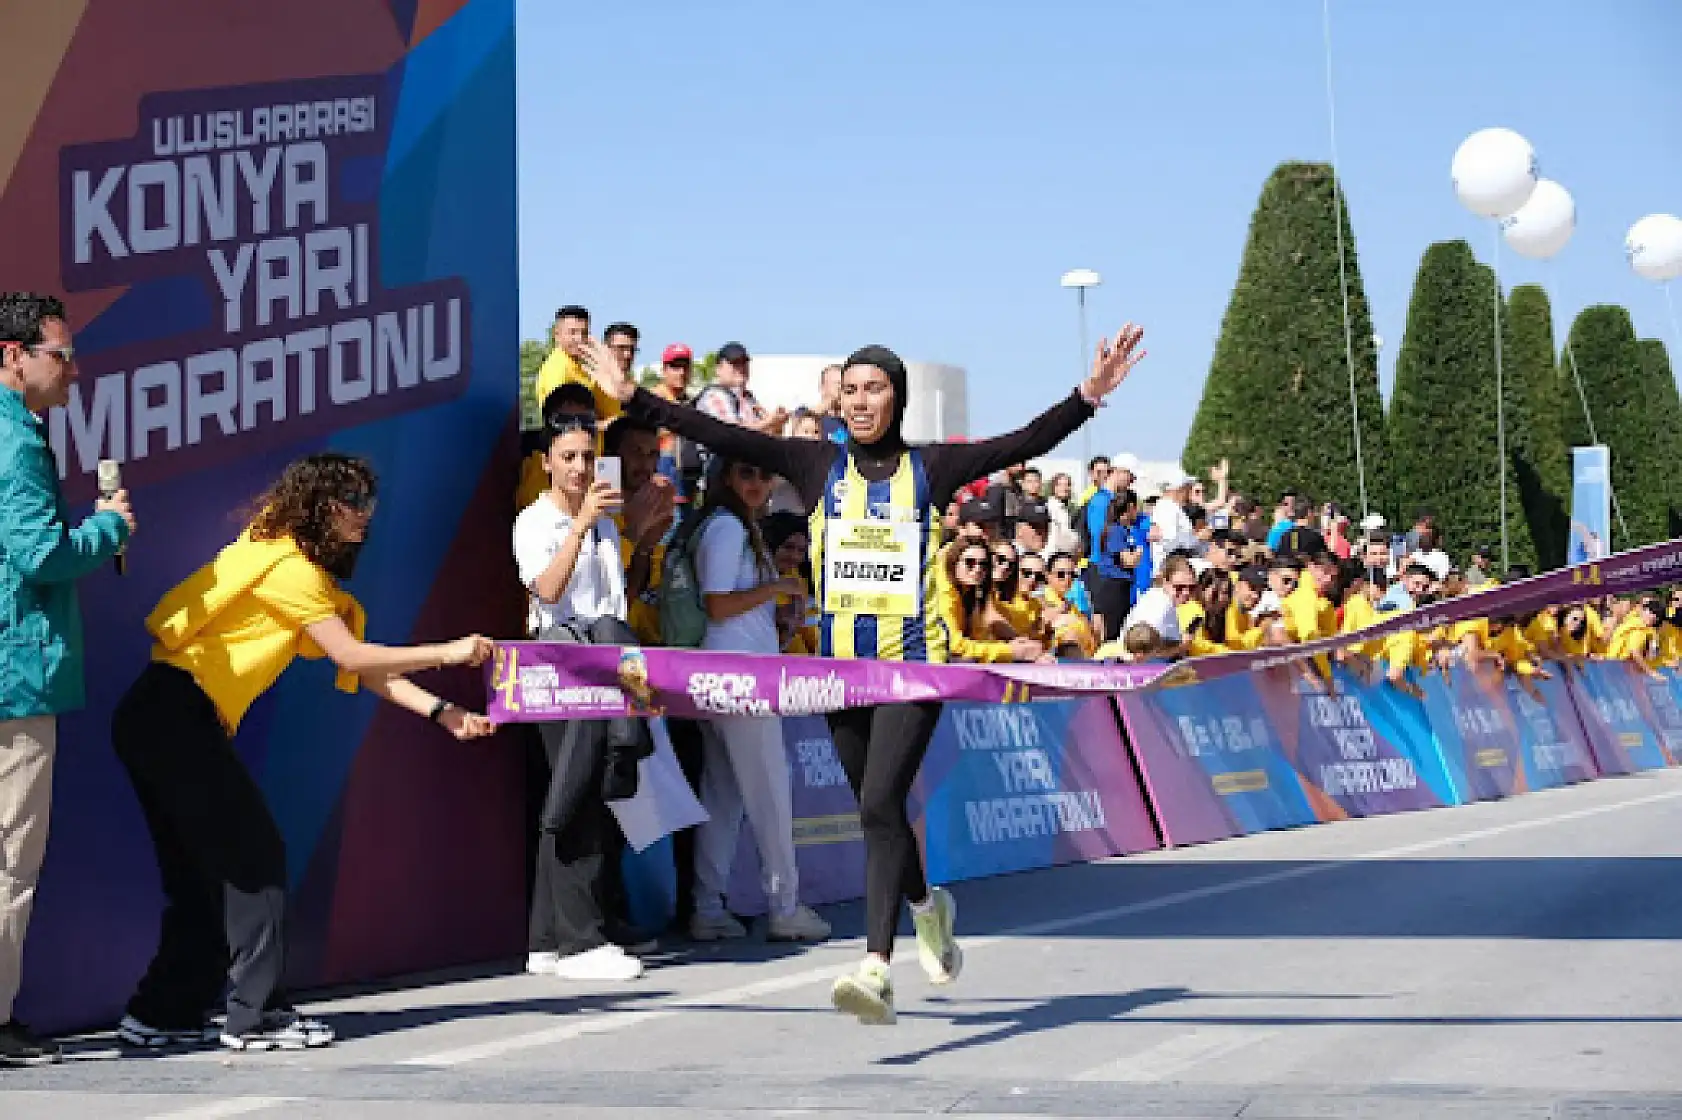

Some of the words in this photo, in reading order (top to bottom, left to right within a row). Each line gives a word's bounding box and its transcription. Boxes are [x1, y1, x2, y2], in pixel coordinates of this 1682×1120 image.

[153, 95, 375, 156] ULUSLARARASI
[72, 140, 329, 264] KONYA
[206, 223, 371, 333] YARI
[49, 298, 462, 481] MARATONU
[952, 708, 1040, 750] KONYA
[991, 749, 1056, 792] YARI
[964, 789, 1106, 845] MARATONU
